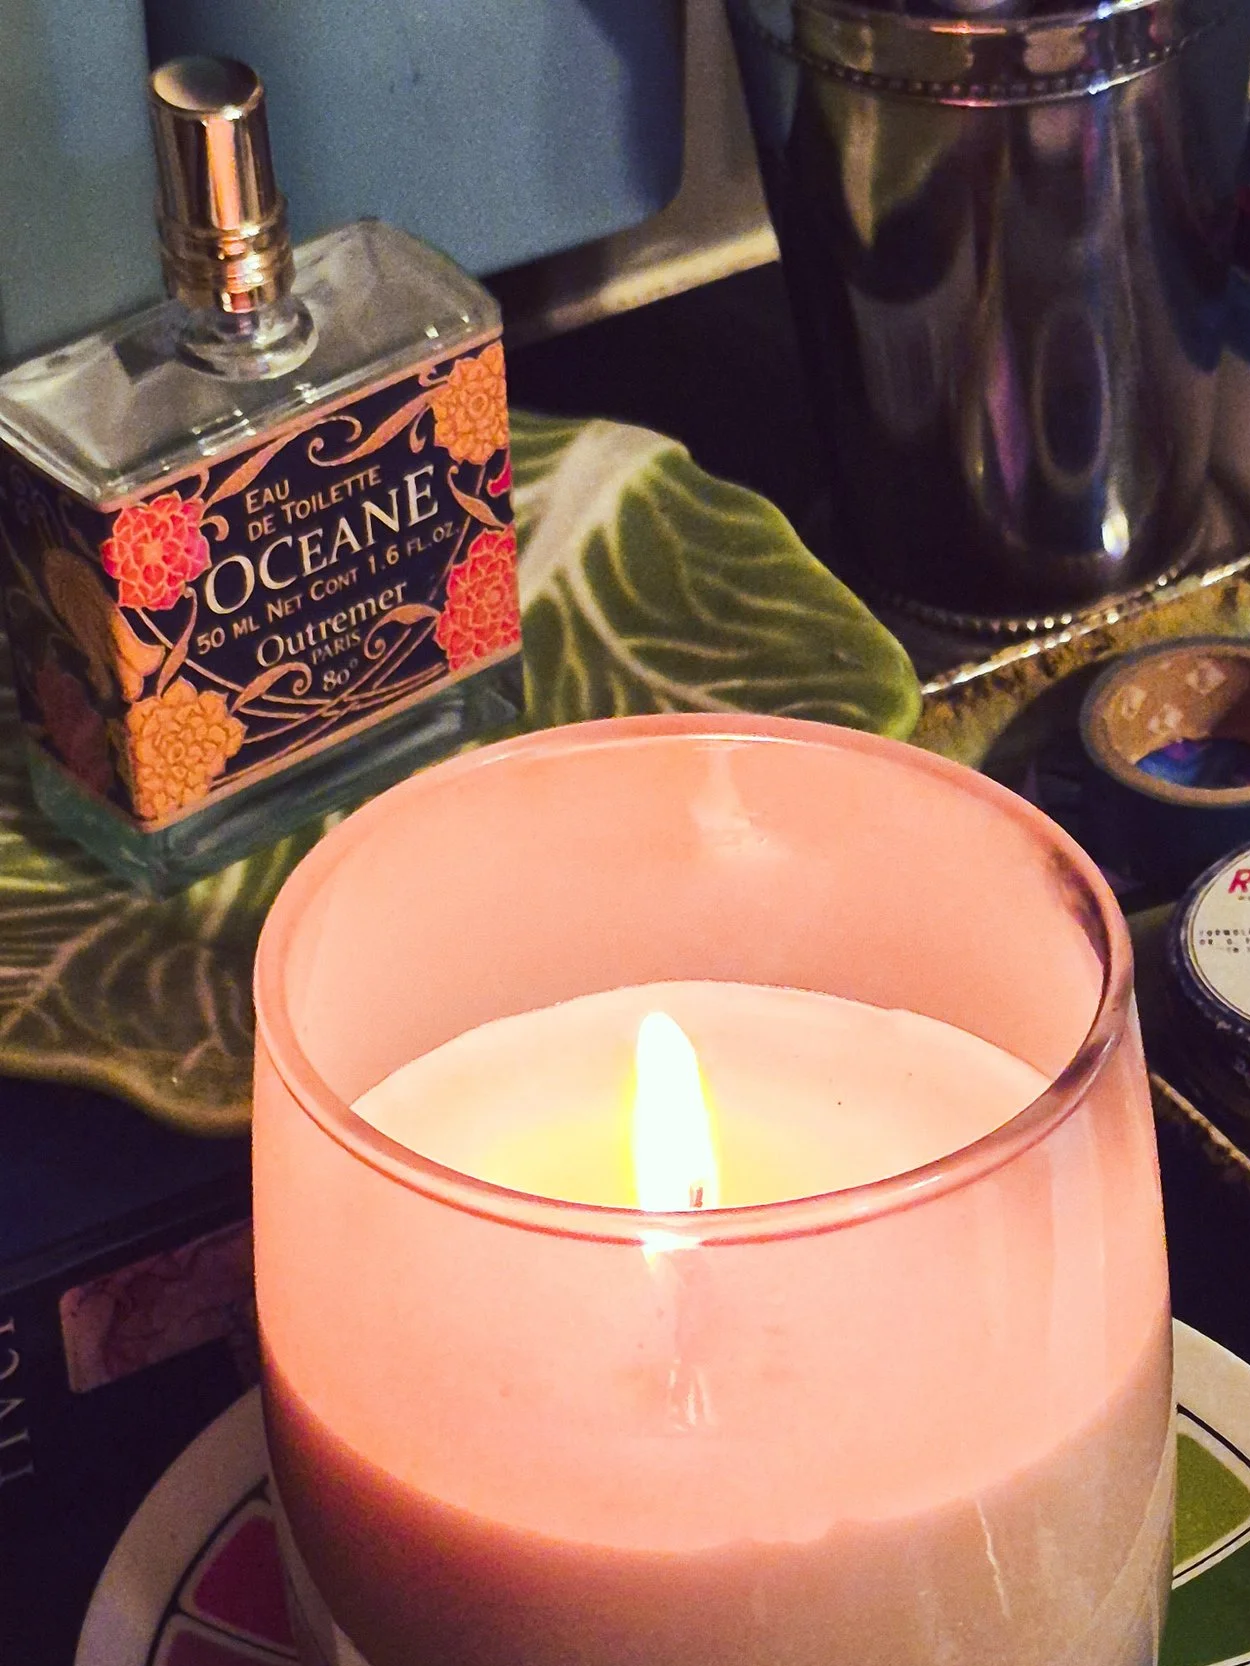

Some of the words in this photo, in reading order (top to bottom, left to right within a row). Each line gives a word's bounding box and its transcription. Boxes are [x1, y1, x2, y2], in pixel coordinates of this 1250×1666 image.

[246, 479, 291, 514] EAU
[248, 514, 276, 541] DE
[281, 465, 382, 524] TOILETTE
[204, 463, 439, 615] OCEANE
[196, 627, 226, 655] 50
[231, 616, 261, 639] ML
[267, 594, 304, 623] NET
[309, 567, 360, 601] CONT
[368, 544, 401, 574] 1.6
[256, 581, 408, 668] Outremer
[312, 628, 363, 665] PARIS
